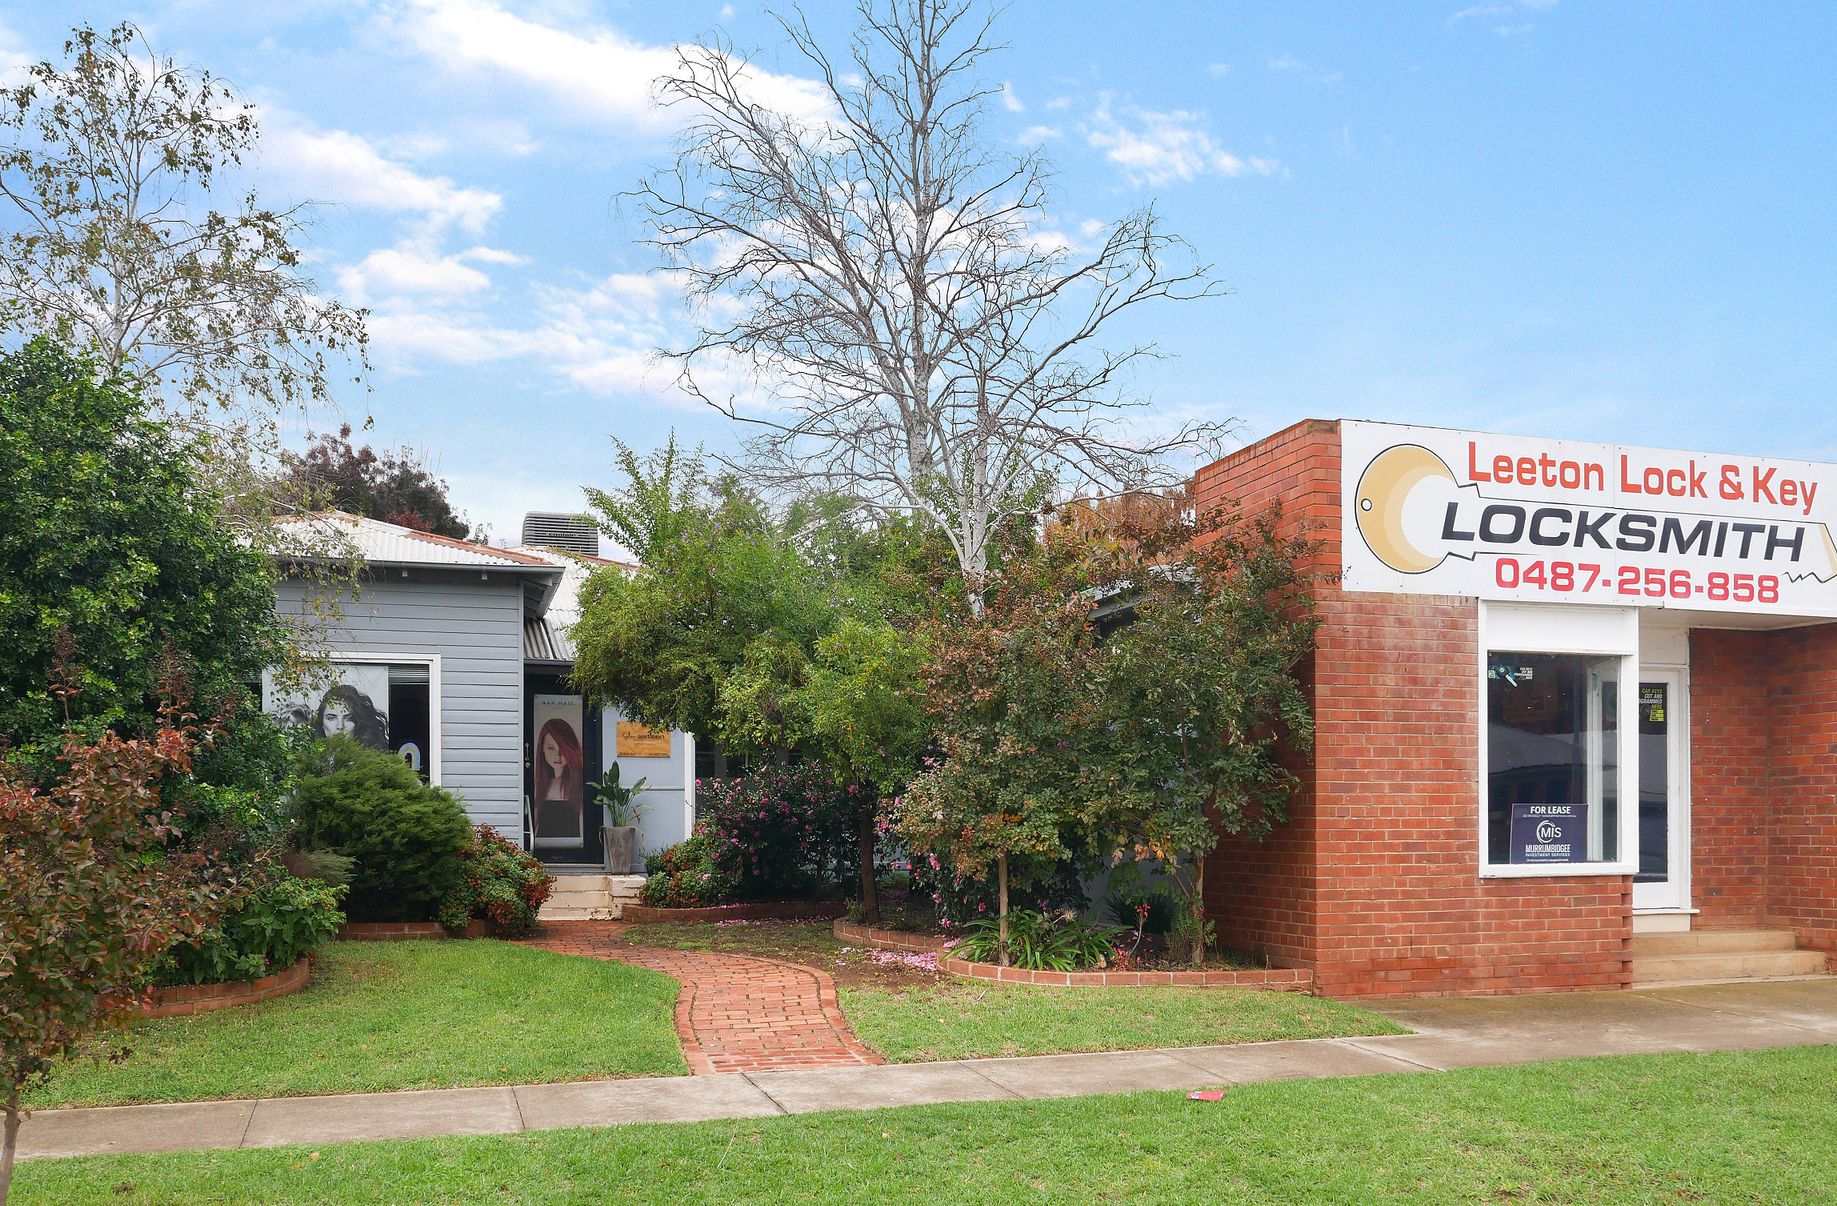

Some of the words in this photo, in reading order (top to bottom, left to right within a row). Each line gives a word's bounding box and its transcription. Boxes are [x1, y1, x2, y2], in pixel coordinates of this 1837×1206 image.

[1469, 441, 1604, 491] Leeton
[1621, 455, 1708, 499] Lock
[1719, 464, 1745, 500] &
[1753, 467, 1818, 515] Key
[1441, 501, 1805, 562] LOCKSMITH
[1496, 557, 1779, 603] 0487-256-858
[1530, 806, 1547, 814] FOR
[1548, 806, 1571, 814] LEASE
[1525, 844, 1571, 853] MURRUMBIDGEE
